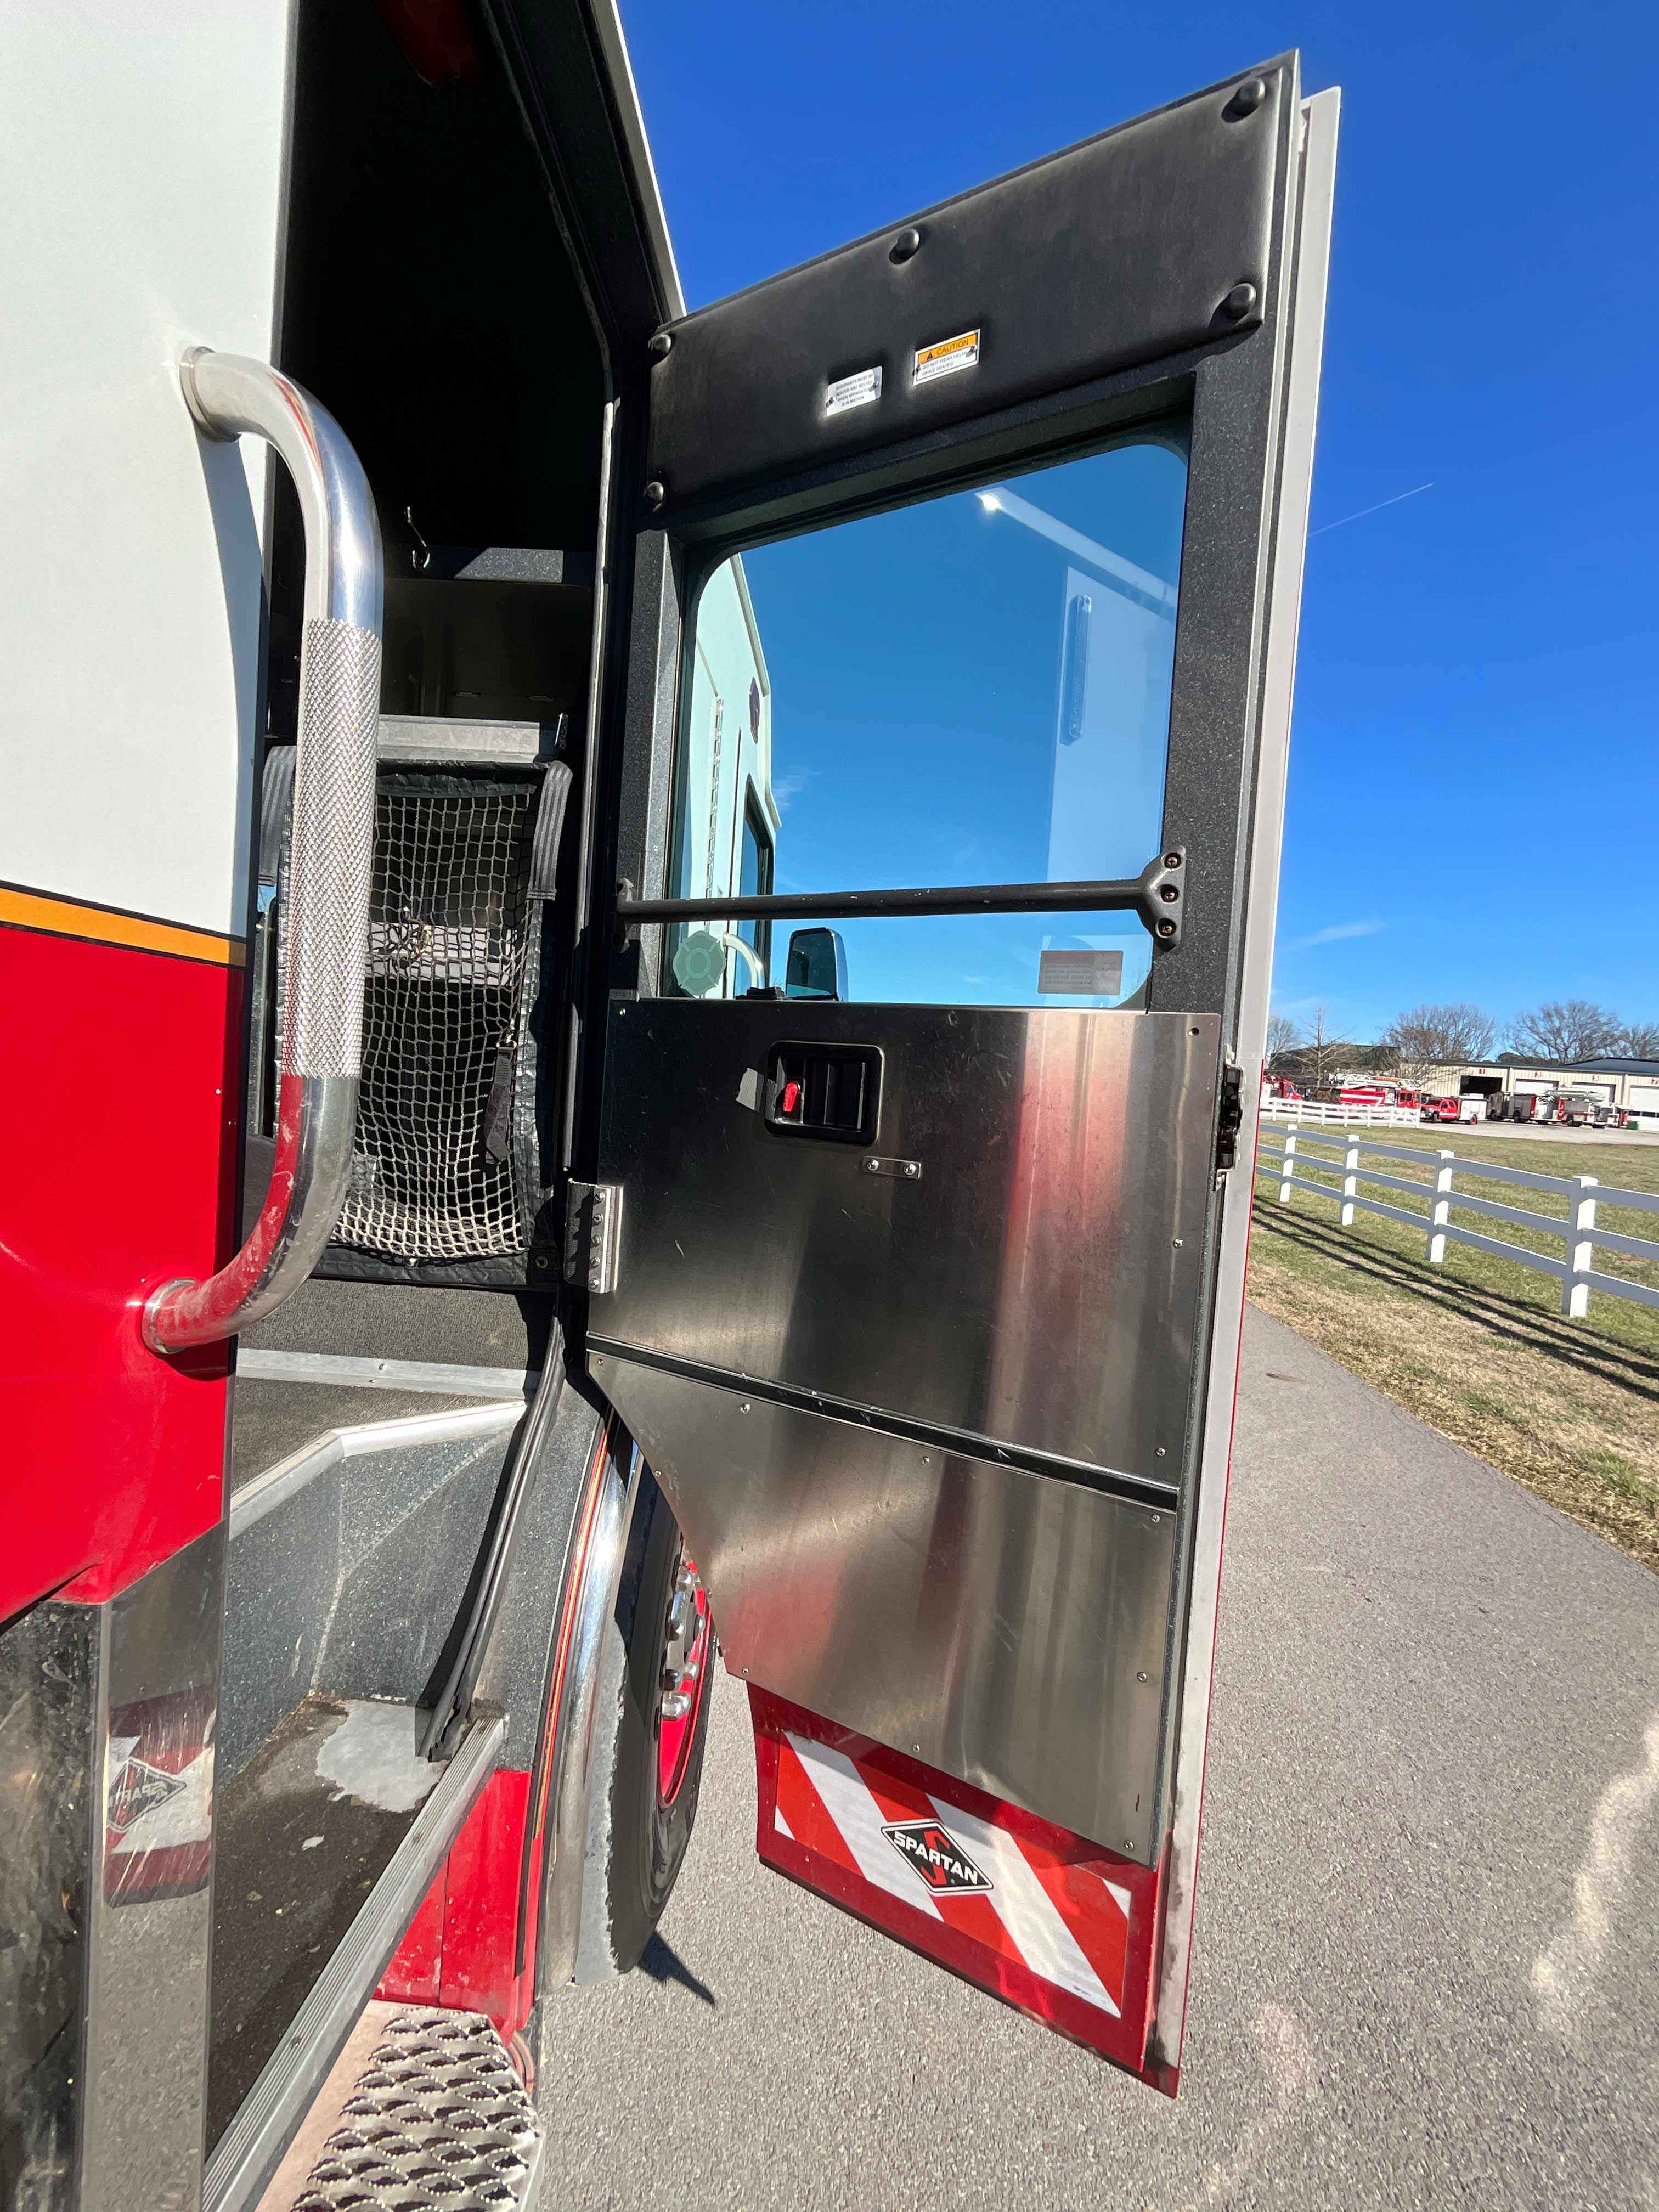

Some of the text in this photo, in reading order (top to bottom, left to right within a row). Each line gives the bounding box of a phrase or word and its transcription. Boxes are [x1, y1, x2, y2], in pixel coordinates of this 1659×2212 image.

[936, 338, 968, 355] CAUTION
[940, 355, 952, 363] WEAR
[922, 362, 953, 376] WHILE SEATED
[836, 388, 849, 396] SEATED
[893, 1831, 978, 1885] SPARTAN
